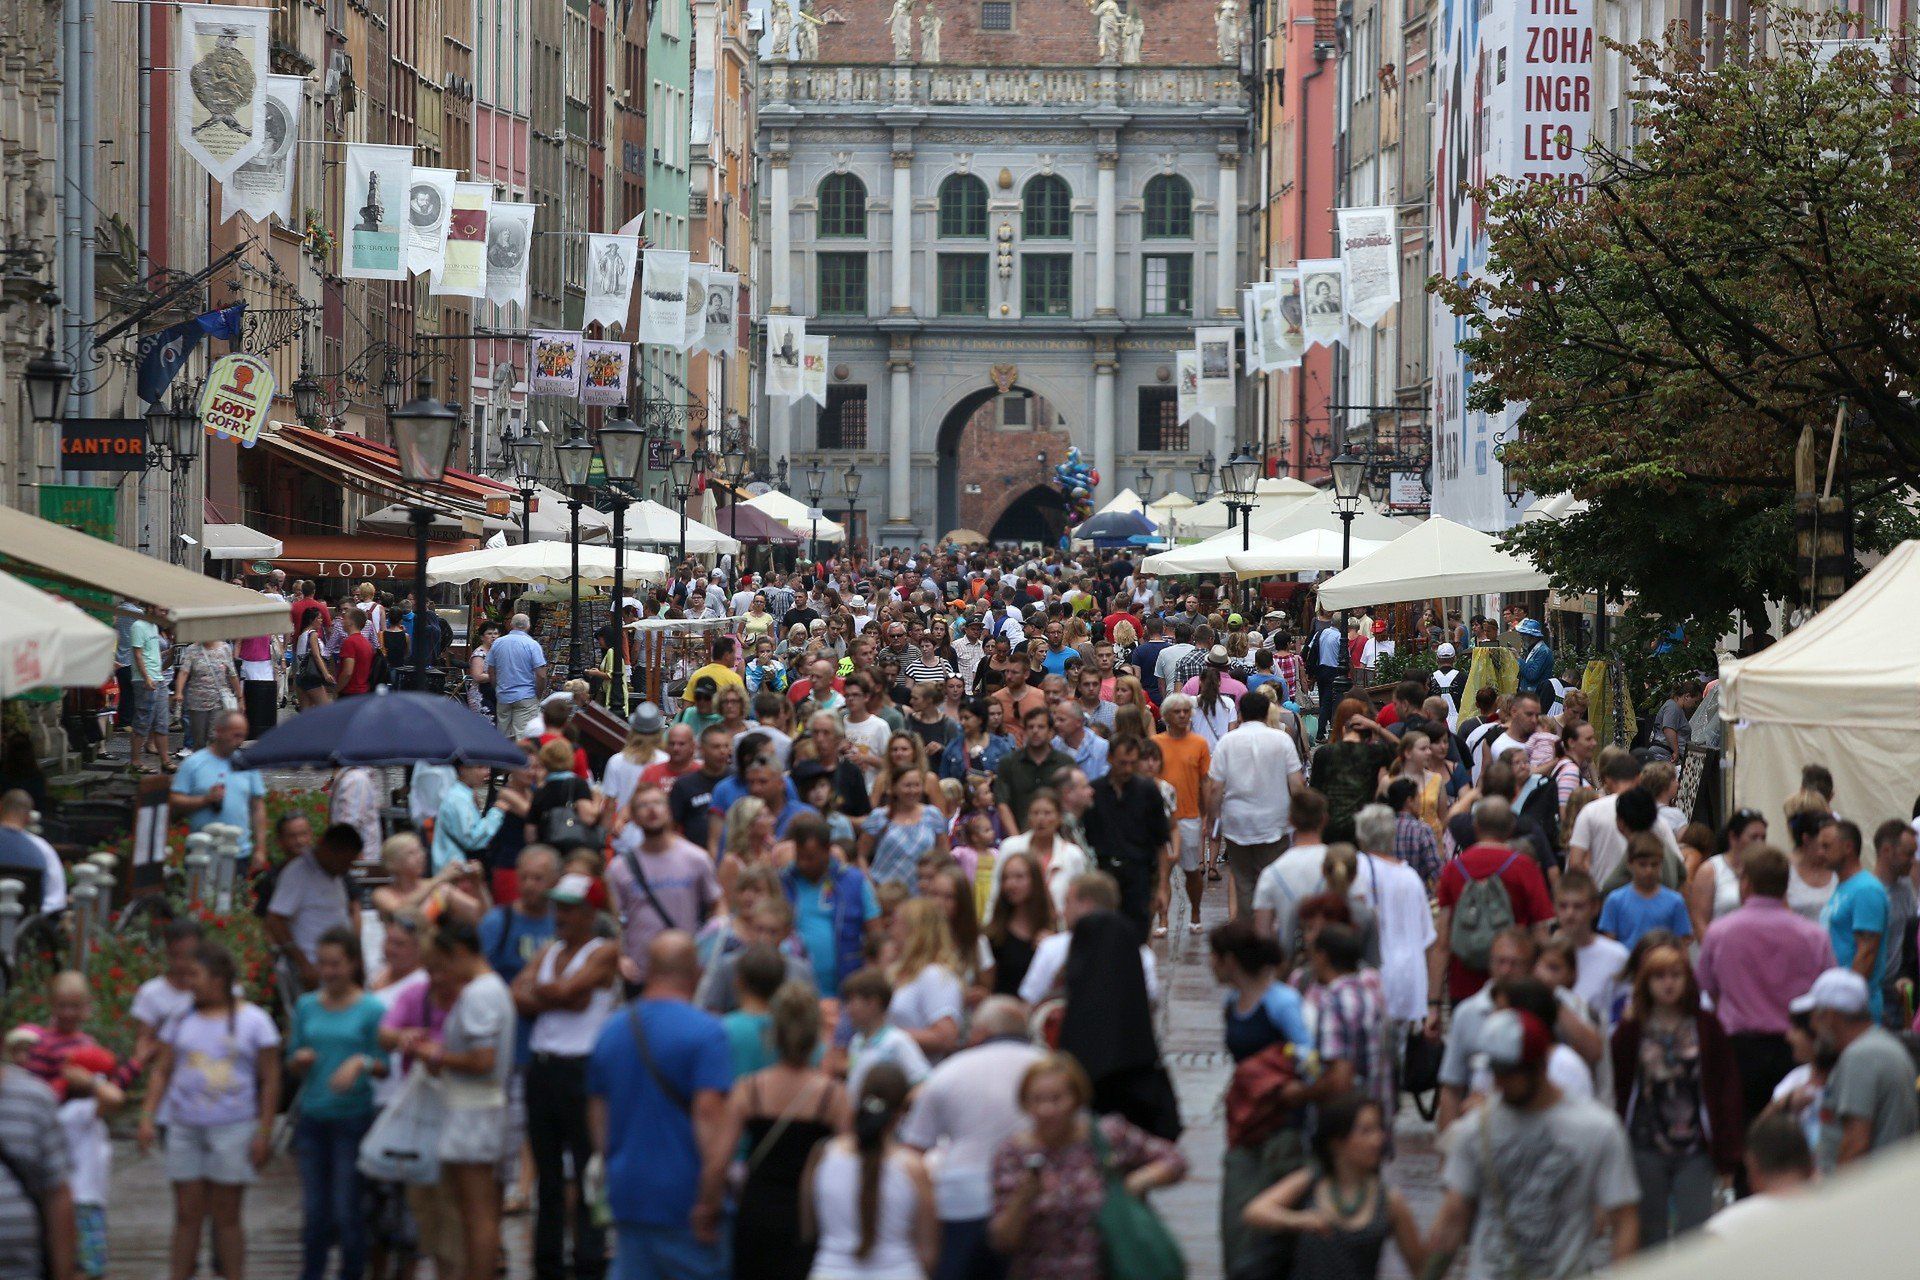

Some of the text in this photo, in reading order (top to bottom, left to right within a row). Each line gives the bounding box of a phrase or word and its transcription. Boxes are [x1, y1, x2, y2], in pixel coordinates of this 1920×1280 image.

[1525, 75, 1591, 112] INGR
[1524, 124, 1573, 161] LEO
[211, 397, 256, 422] LODY
[206, 412, 251, 435] GOFRY
[318, 562, 398, 578] LODY
